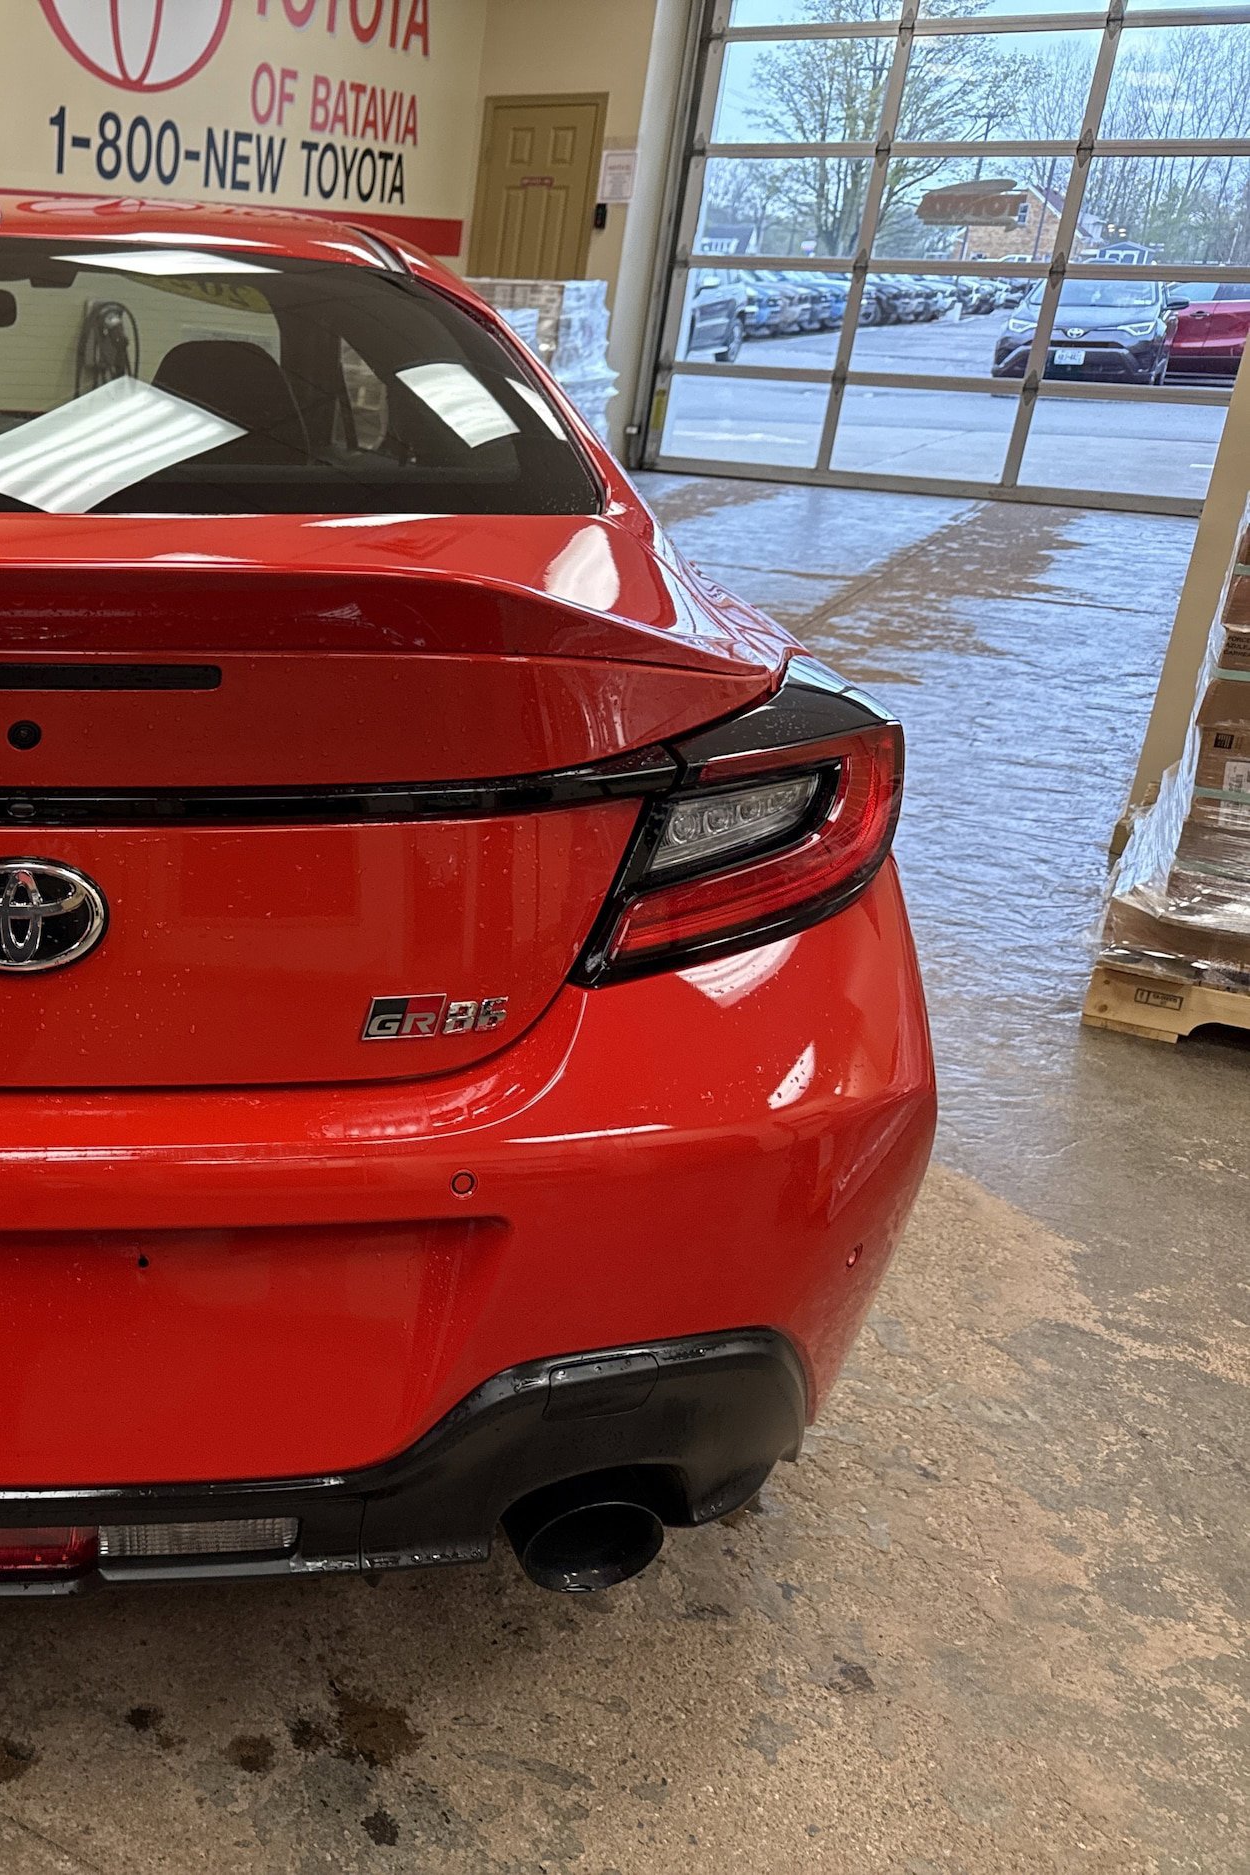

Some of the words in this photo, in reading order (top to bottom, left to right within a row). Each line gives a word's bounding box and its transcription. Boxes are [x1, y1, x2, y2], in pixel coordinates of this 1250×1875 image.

[251, 62, 298, 126] OF
[310, 73, 418, 146] BATAVIA
[50, 105, 286, 194] 1-800-NEW
[300, 140, 406, 204] TOYOTA
[367, 1011, 437, 1036] GR
[442, 996, 509, 1035] 86
